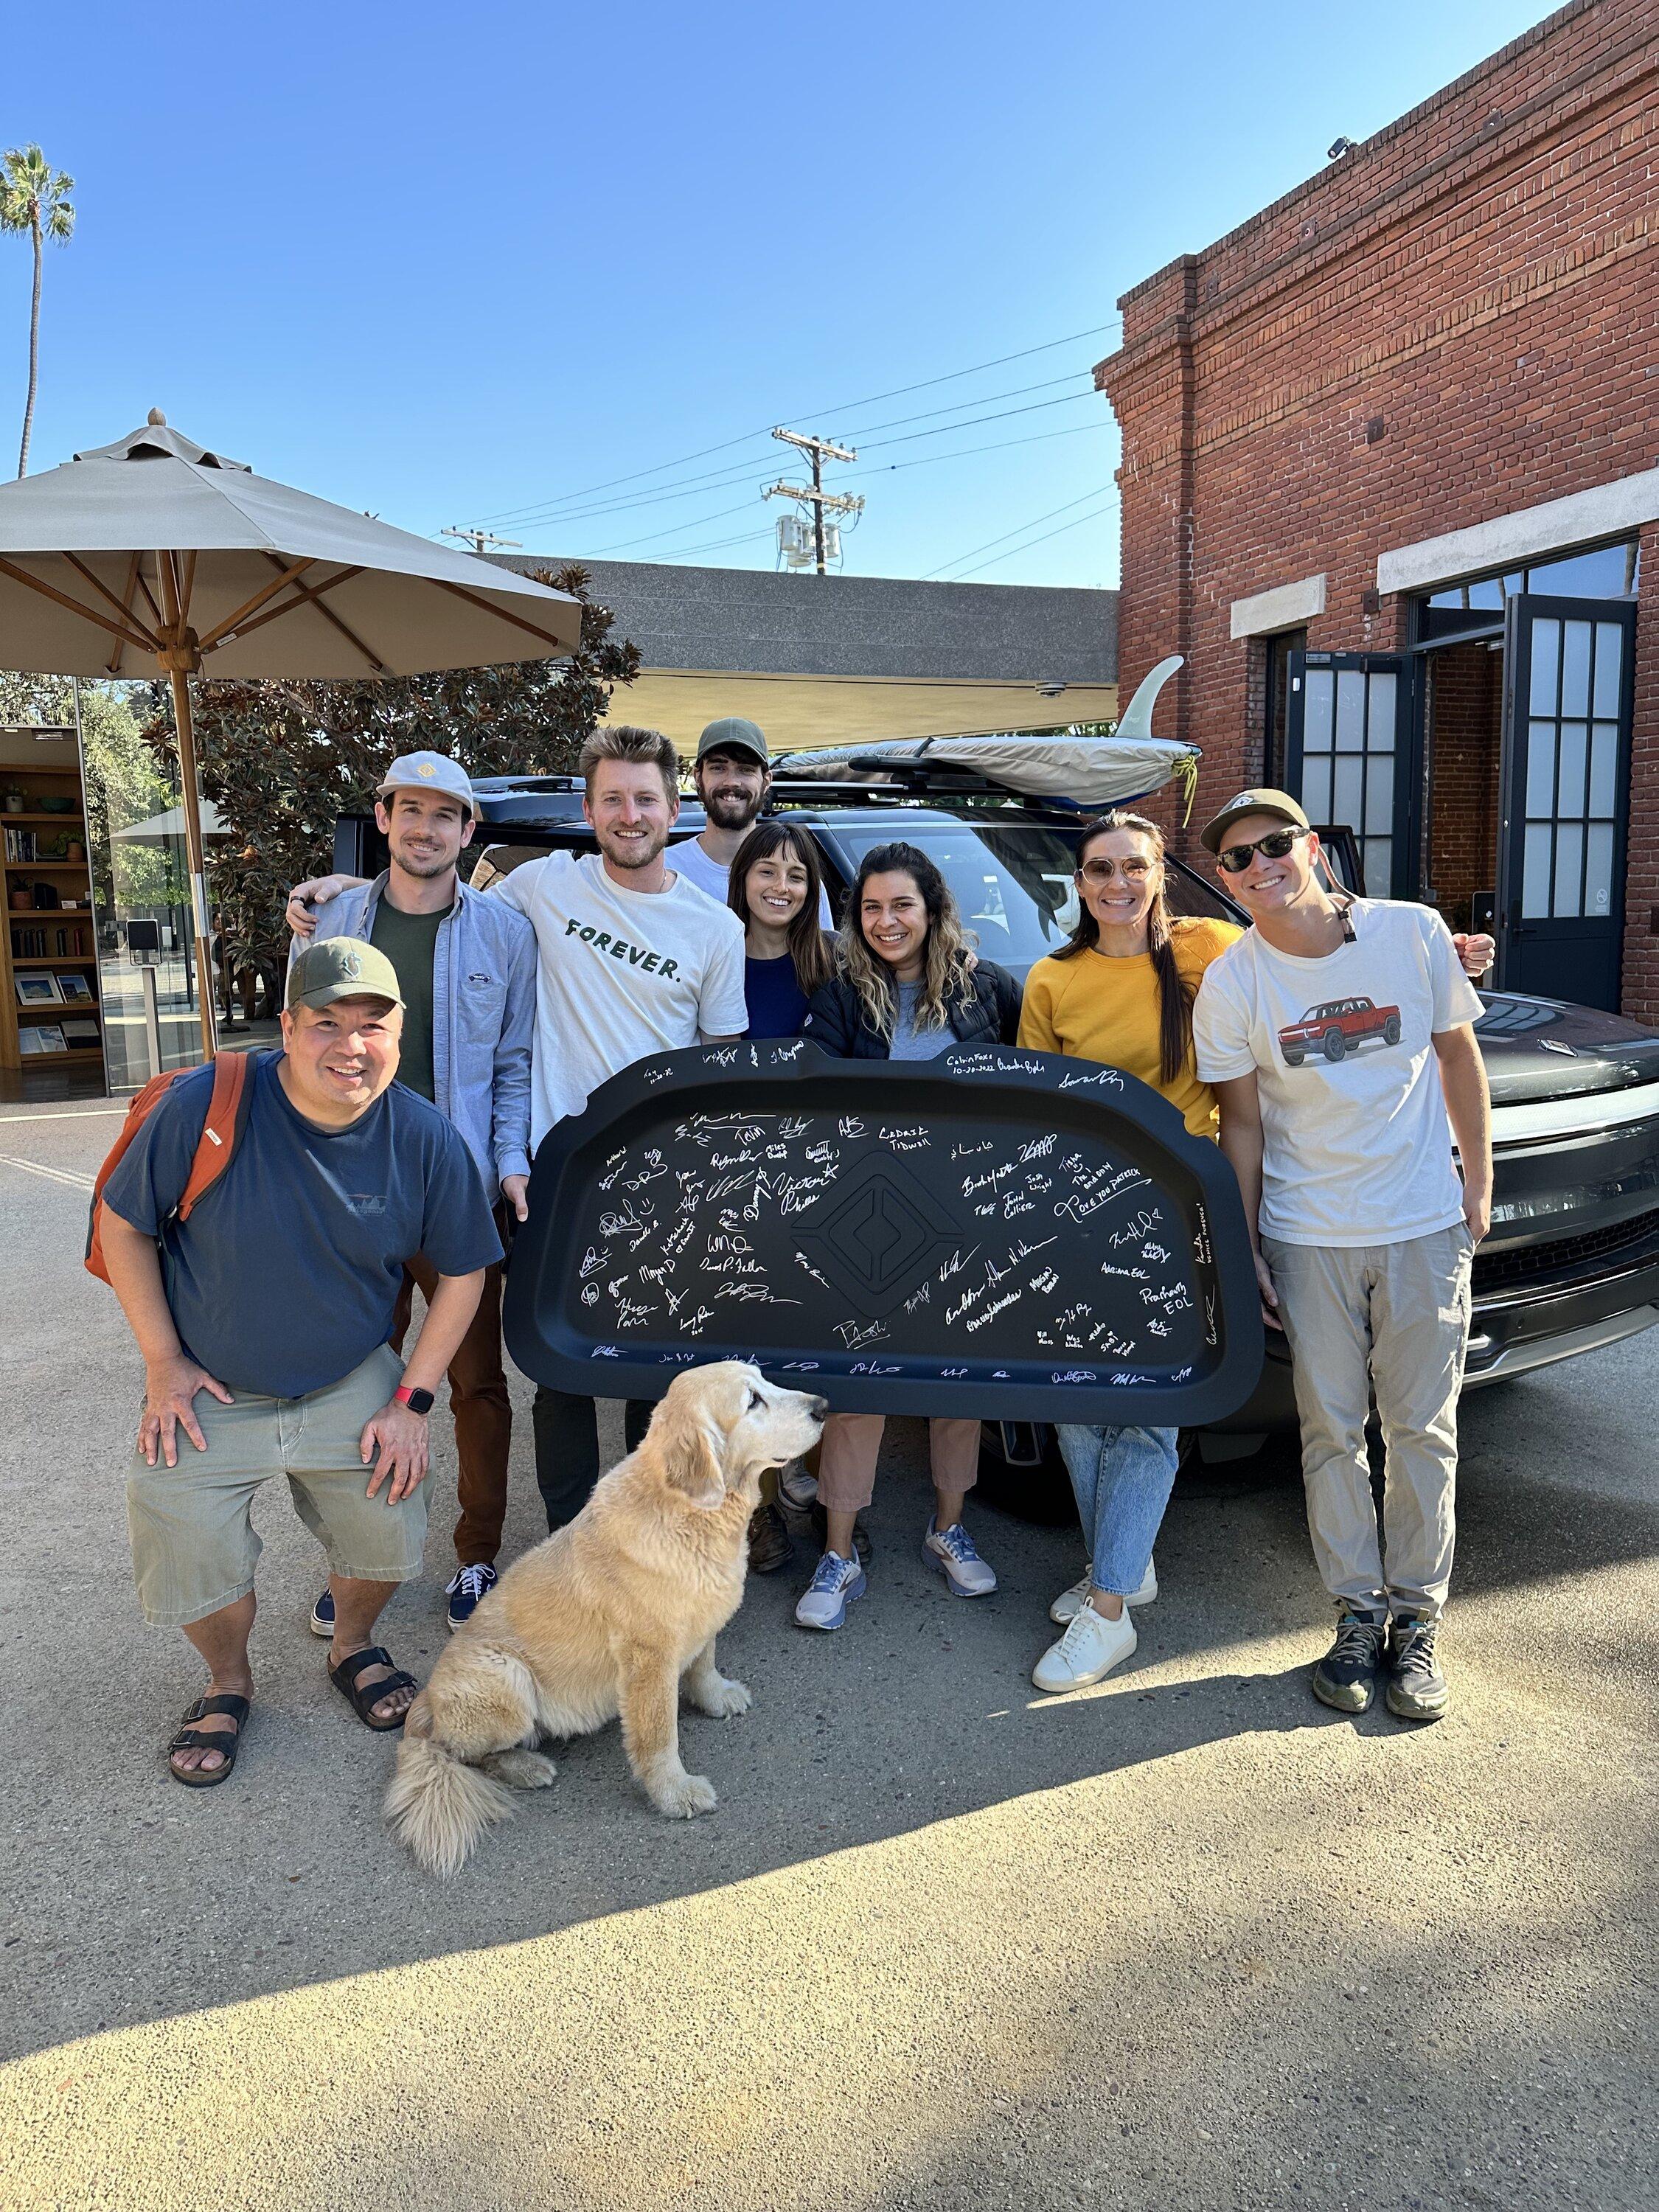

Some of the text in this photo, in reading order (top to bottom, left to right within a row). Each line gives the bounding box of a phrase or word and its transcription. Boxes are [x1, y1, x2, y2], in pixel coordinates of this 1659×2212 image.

[565, 918, 681, 983] FOREVER.
[734, 1126, 766, 1146] Tevin
[765, 1143, 787, 1152] Miles
[1072, 1173, 1088, 1185] The
[1084, 1176, 1099, 1189] and
[1109, 1168, 1141, 1190] PATRICK
[1163, 1296, 1194, 1315] EOL
